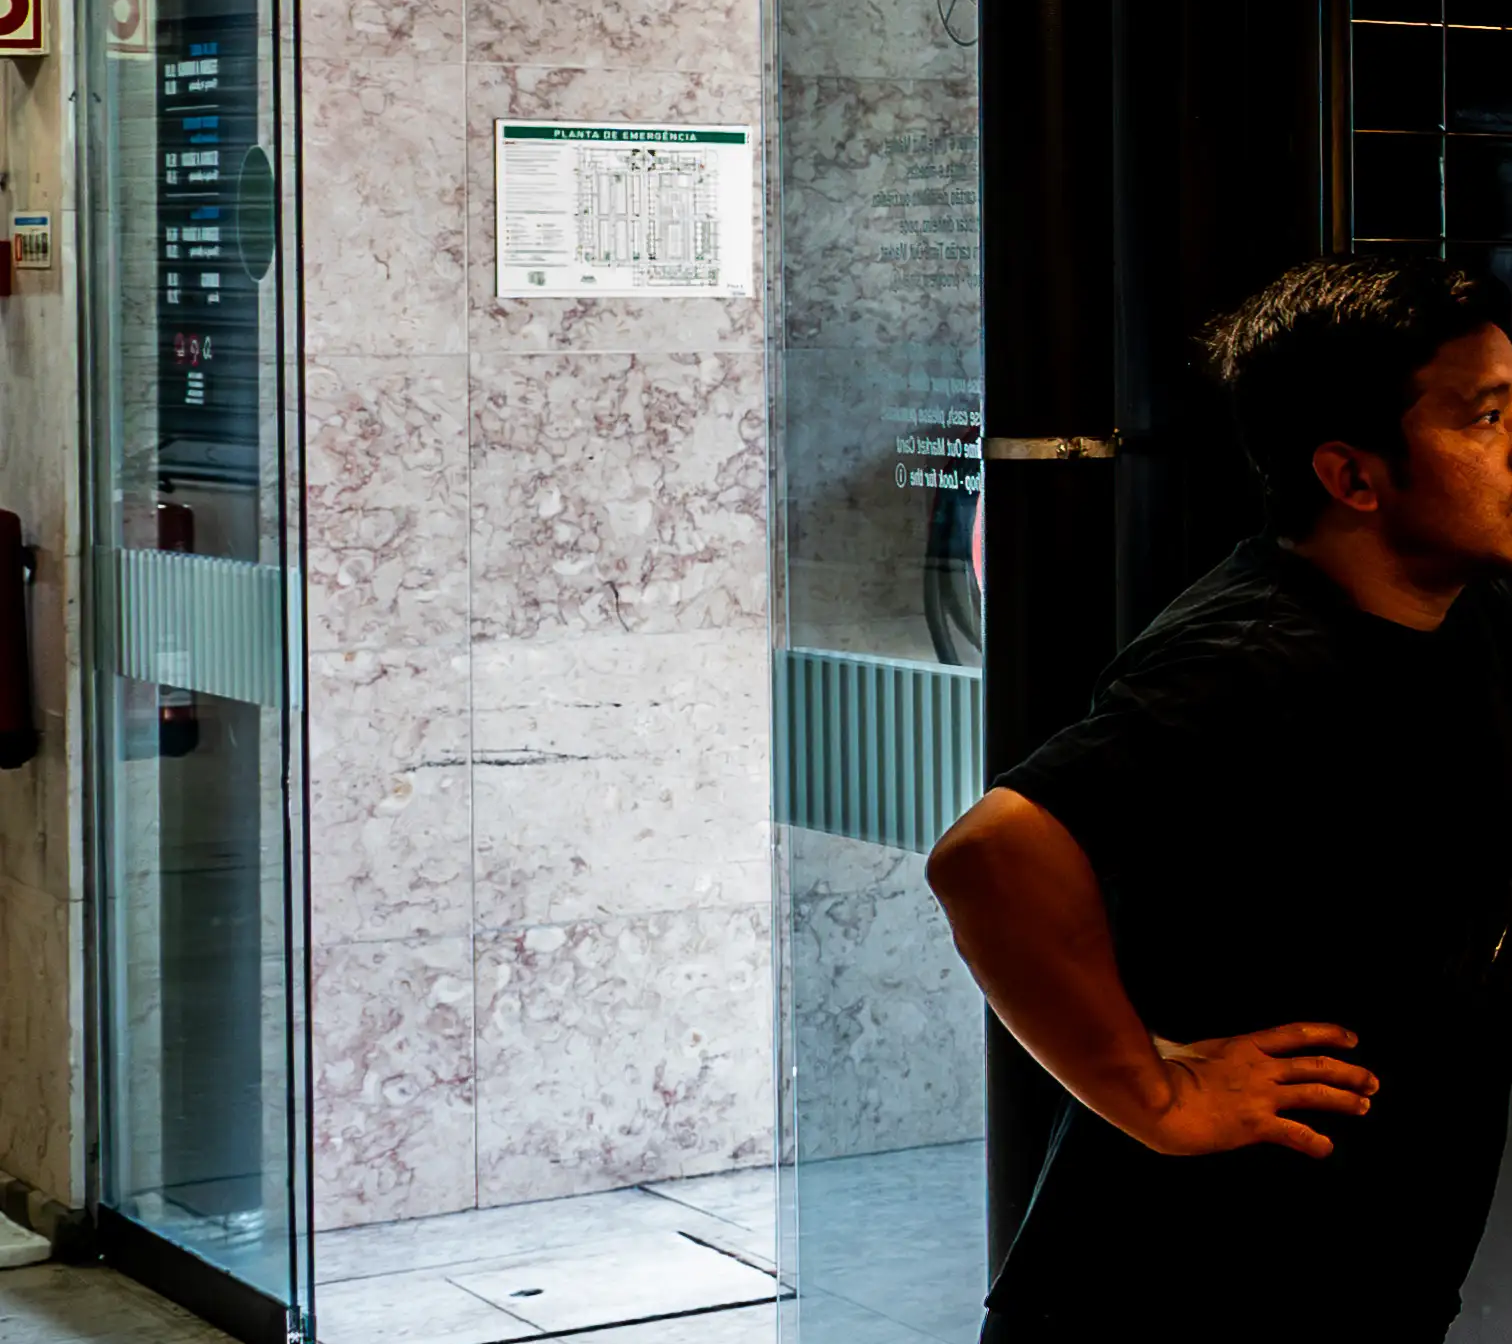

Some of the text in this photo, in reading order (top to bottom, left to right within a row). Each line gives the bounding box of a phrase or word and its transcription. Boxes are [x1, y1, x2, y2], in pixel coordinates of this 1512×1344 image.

[553, 129, 698, 142] PLANTA DE EMERGÊNCIA
